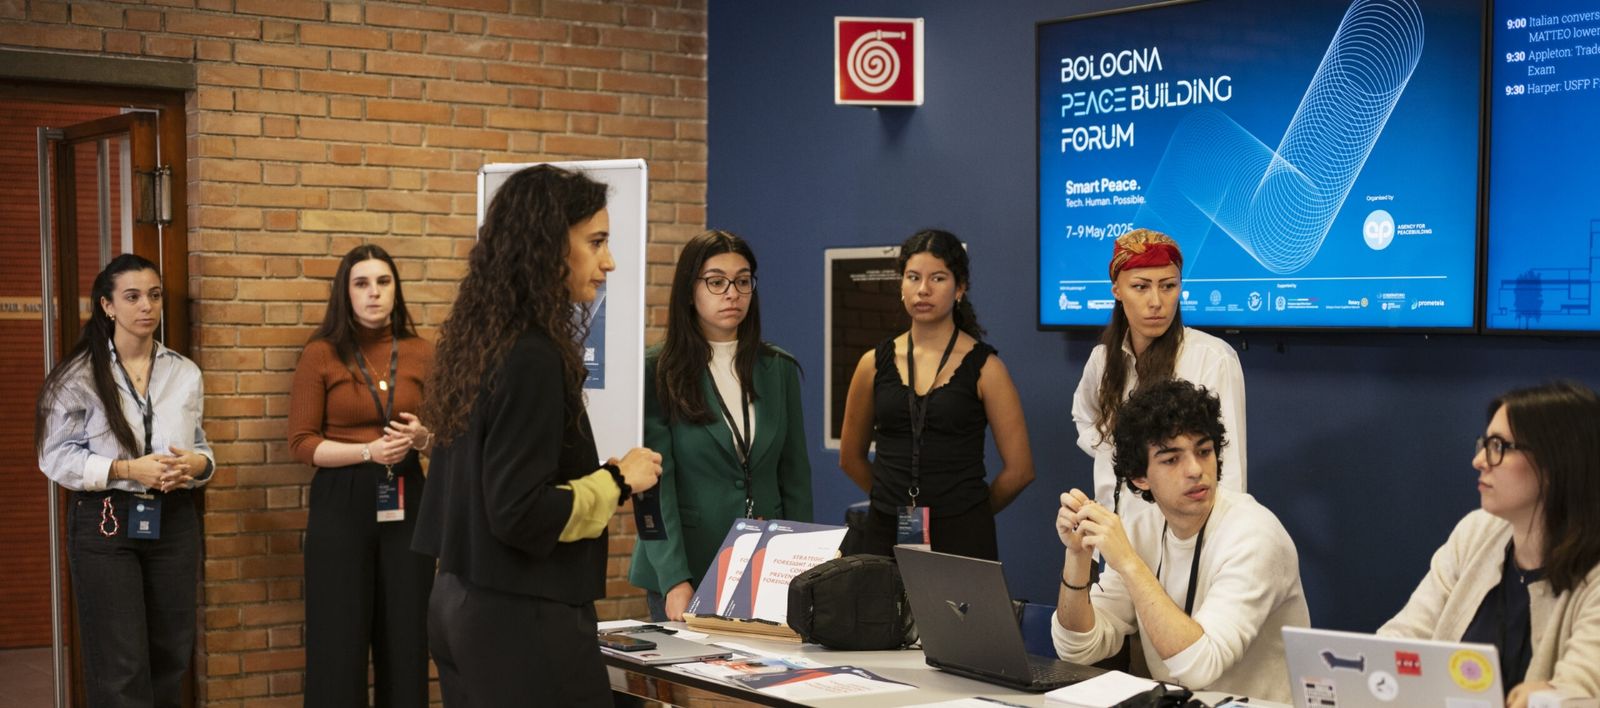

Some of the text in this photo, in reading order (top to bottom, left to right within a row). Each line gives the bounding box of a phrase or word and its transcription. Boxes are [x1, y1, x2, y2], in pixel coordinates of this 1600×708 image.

[1507, 18, 1526, 29] 9:00
[1529, 15, 1559, 27] Italian
[1529, 28, 1571, 42] MATTEO
[1506, 51, 1526, 62] 9:30
[1528, 48, 1573, 62] Appleton:
[1061, 46, 1163, 83] BOLOGNA
[1528, 65, 1555, 76] Exam
[1505, 84, 1525, 96] 9:30
[1527, 83, 1562, 95] Harper:
[1564, 79, 1591, 91] USFP
[1062, 75, 1232, 118] PEACE BUILDING
[1062, 122, 1135, 153] FORUM
[1066, 178, 1141, 195] Smart Peace.
[1066, 194, 1146, 208] Tech. Human. Possible.
[1086, 225, 1106, 240] May
